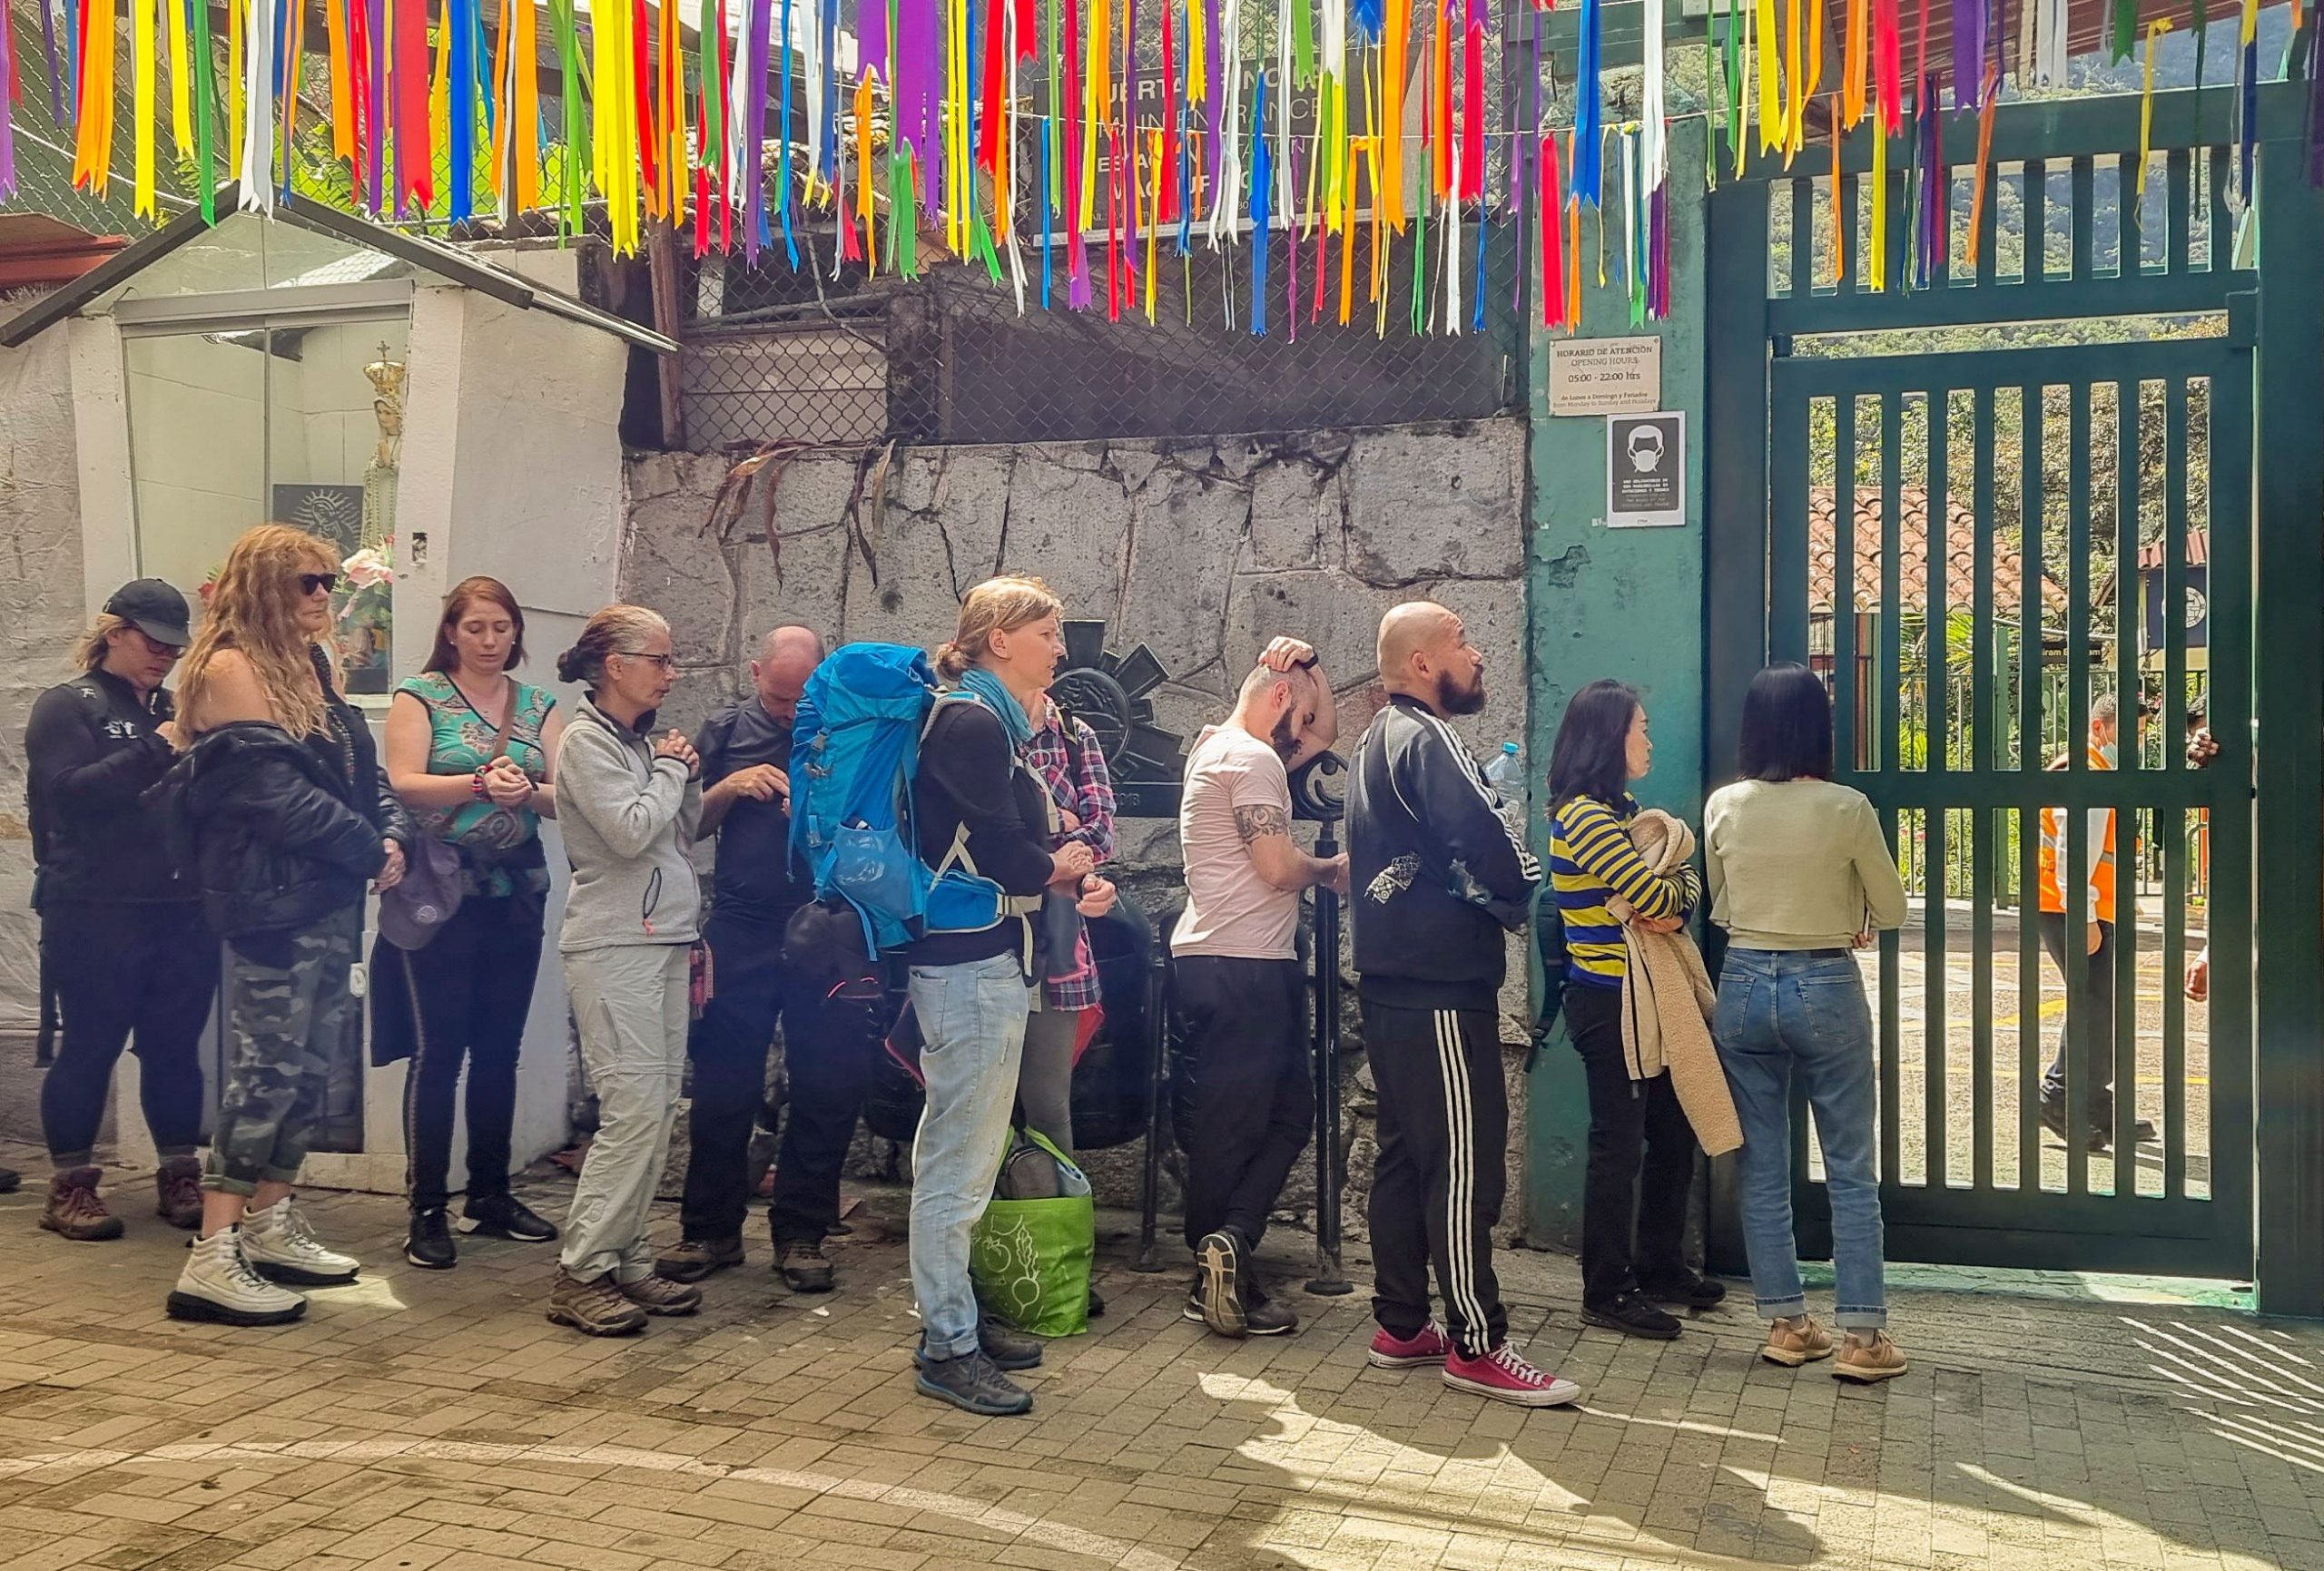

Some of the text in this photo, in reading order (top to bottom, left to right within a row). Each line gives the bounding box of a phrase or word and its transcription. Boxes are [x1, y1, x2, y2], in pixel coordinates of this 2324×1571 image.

[1556, 349, 1595, 358] HORARIO
[1597, 348, 1608, 356] DE
[1571, 357, 1608, 367] OPENING
[1568, 373, 1592, 383] 05:00
[1600, 372, 1624, 382] 22:00
